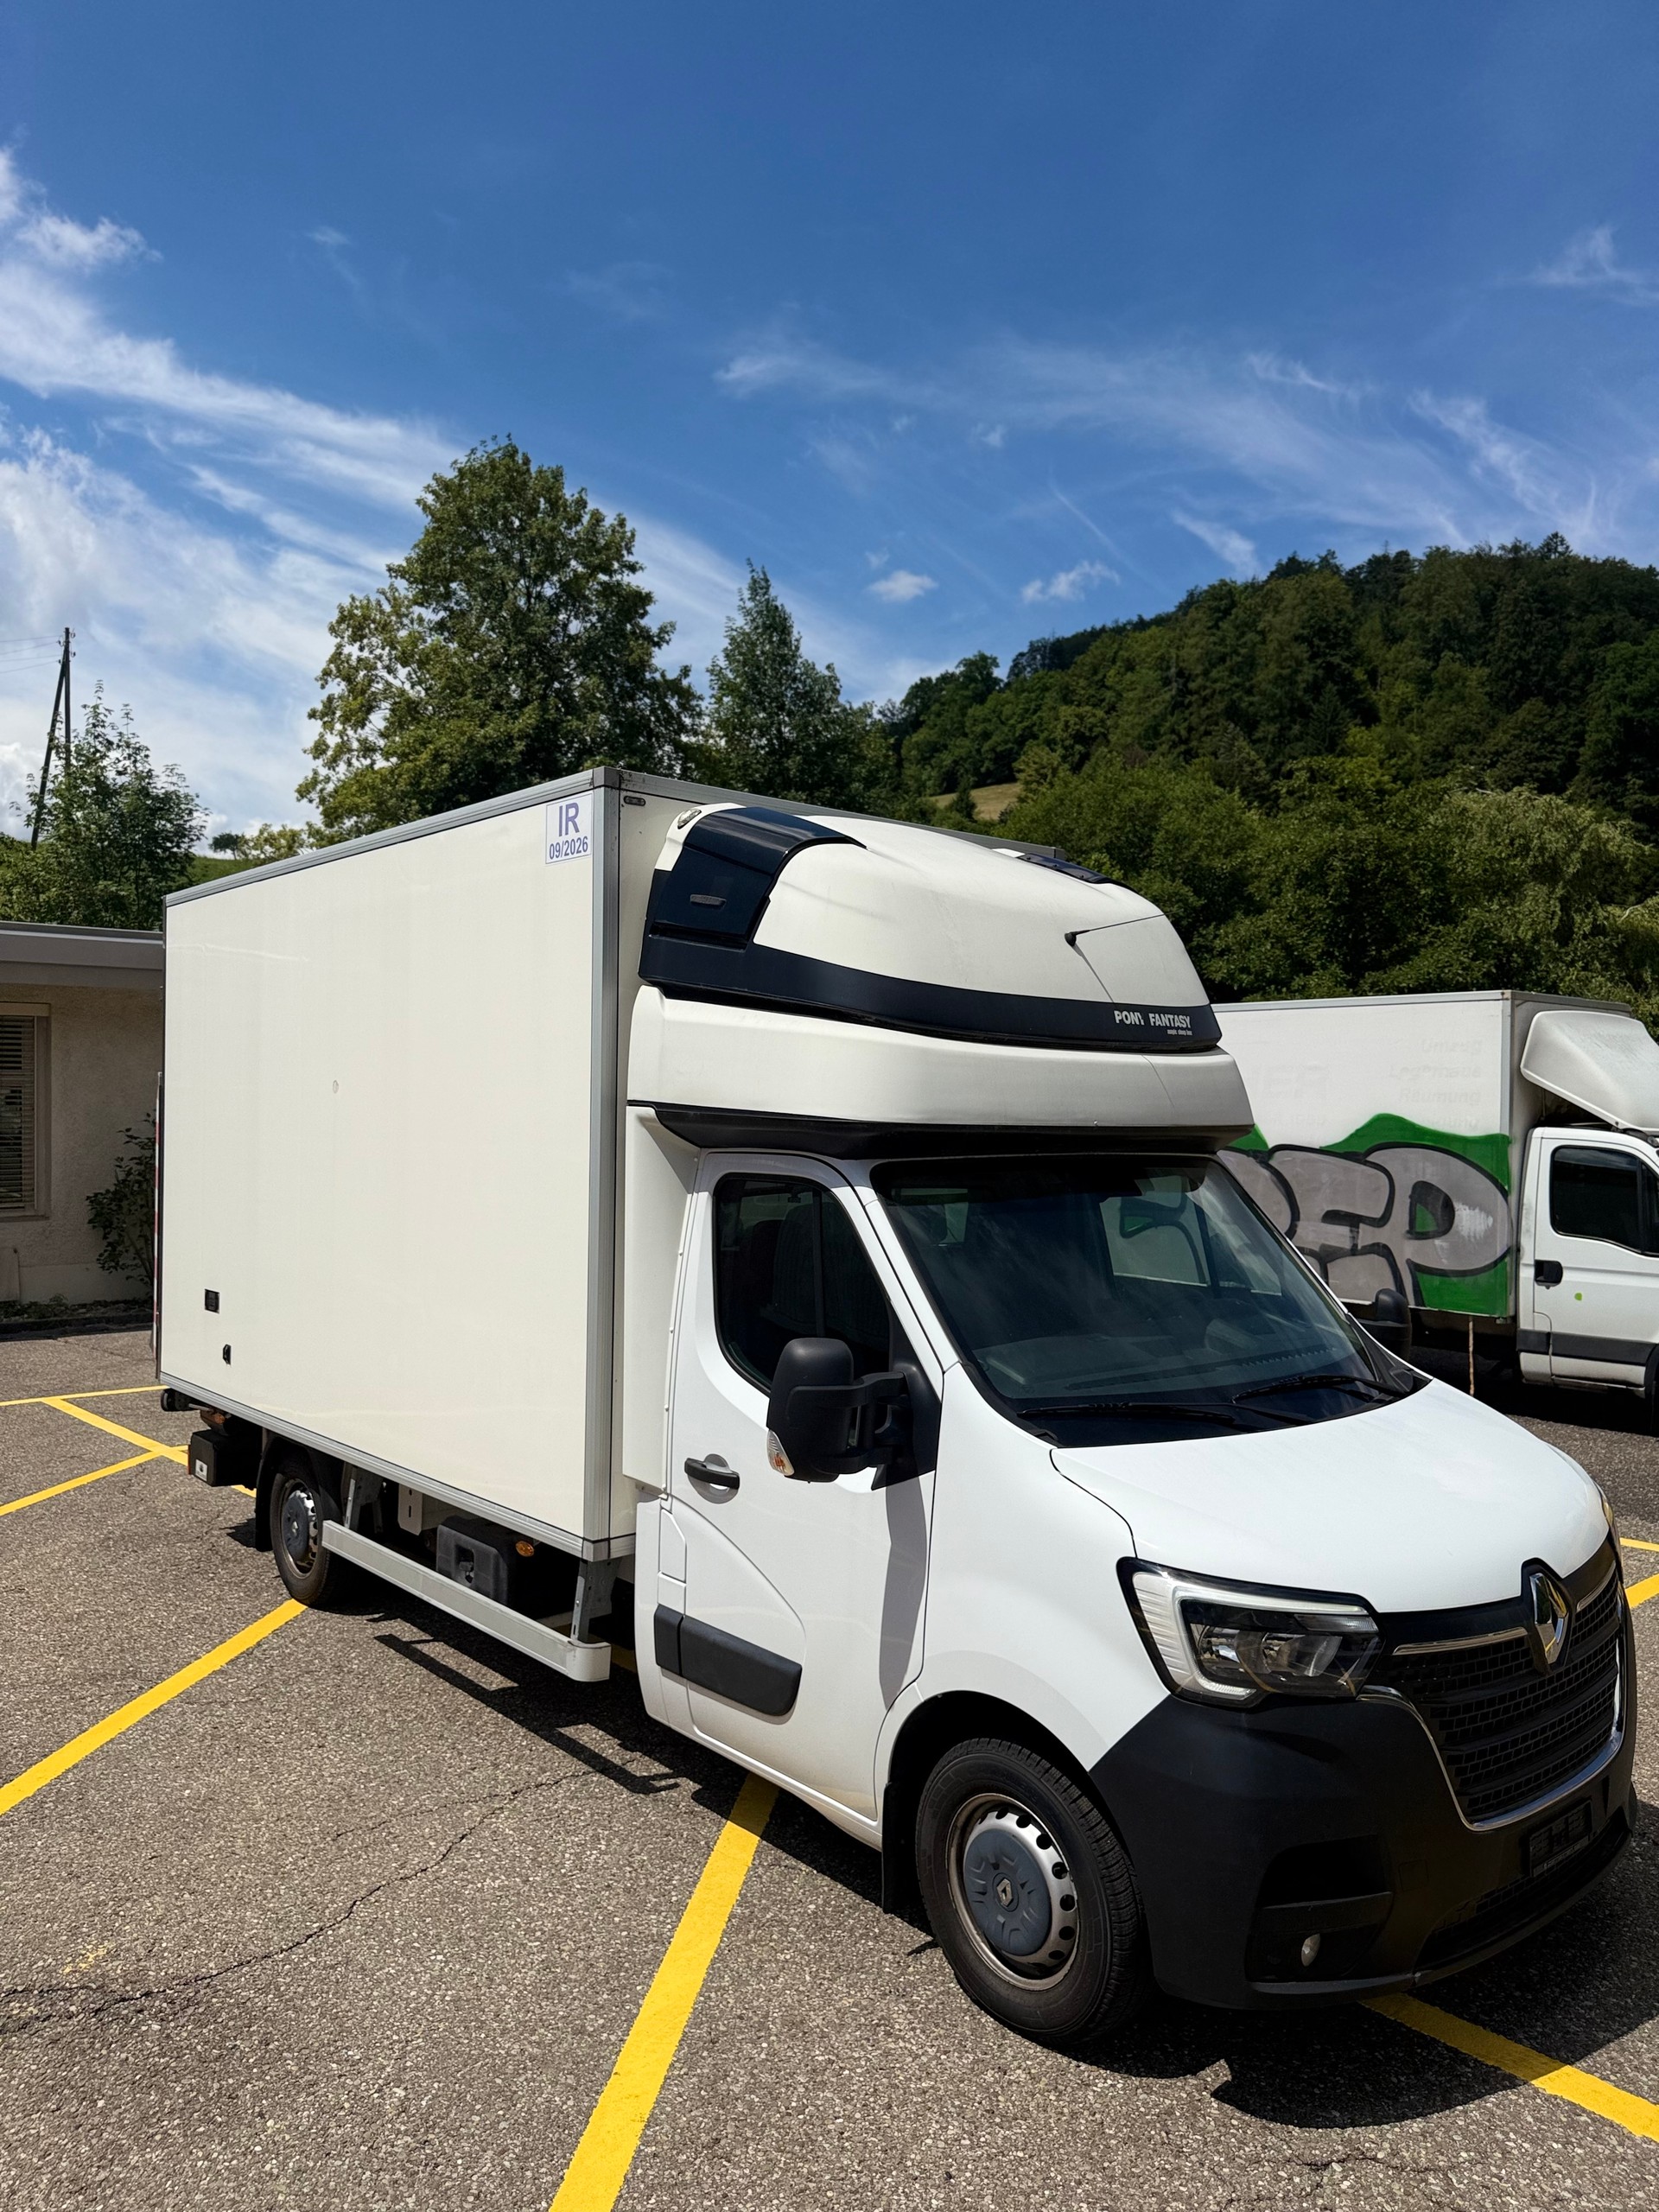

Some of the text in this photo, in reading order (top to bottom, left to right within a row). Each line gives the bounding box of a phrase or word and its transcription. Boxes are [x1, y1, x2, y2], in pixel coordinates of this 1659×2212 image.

[558, 802, 580, 836] IR
[549, 836, 588, 860] 09/2026
[1148, 1013, 1192, 1028] FANTASY
